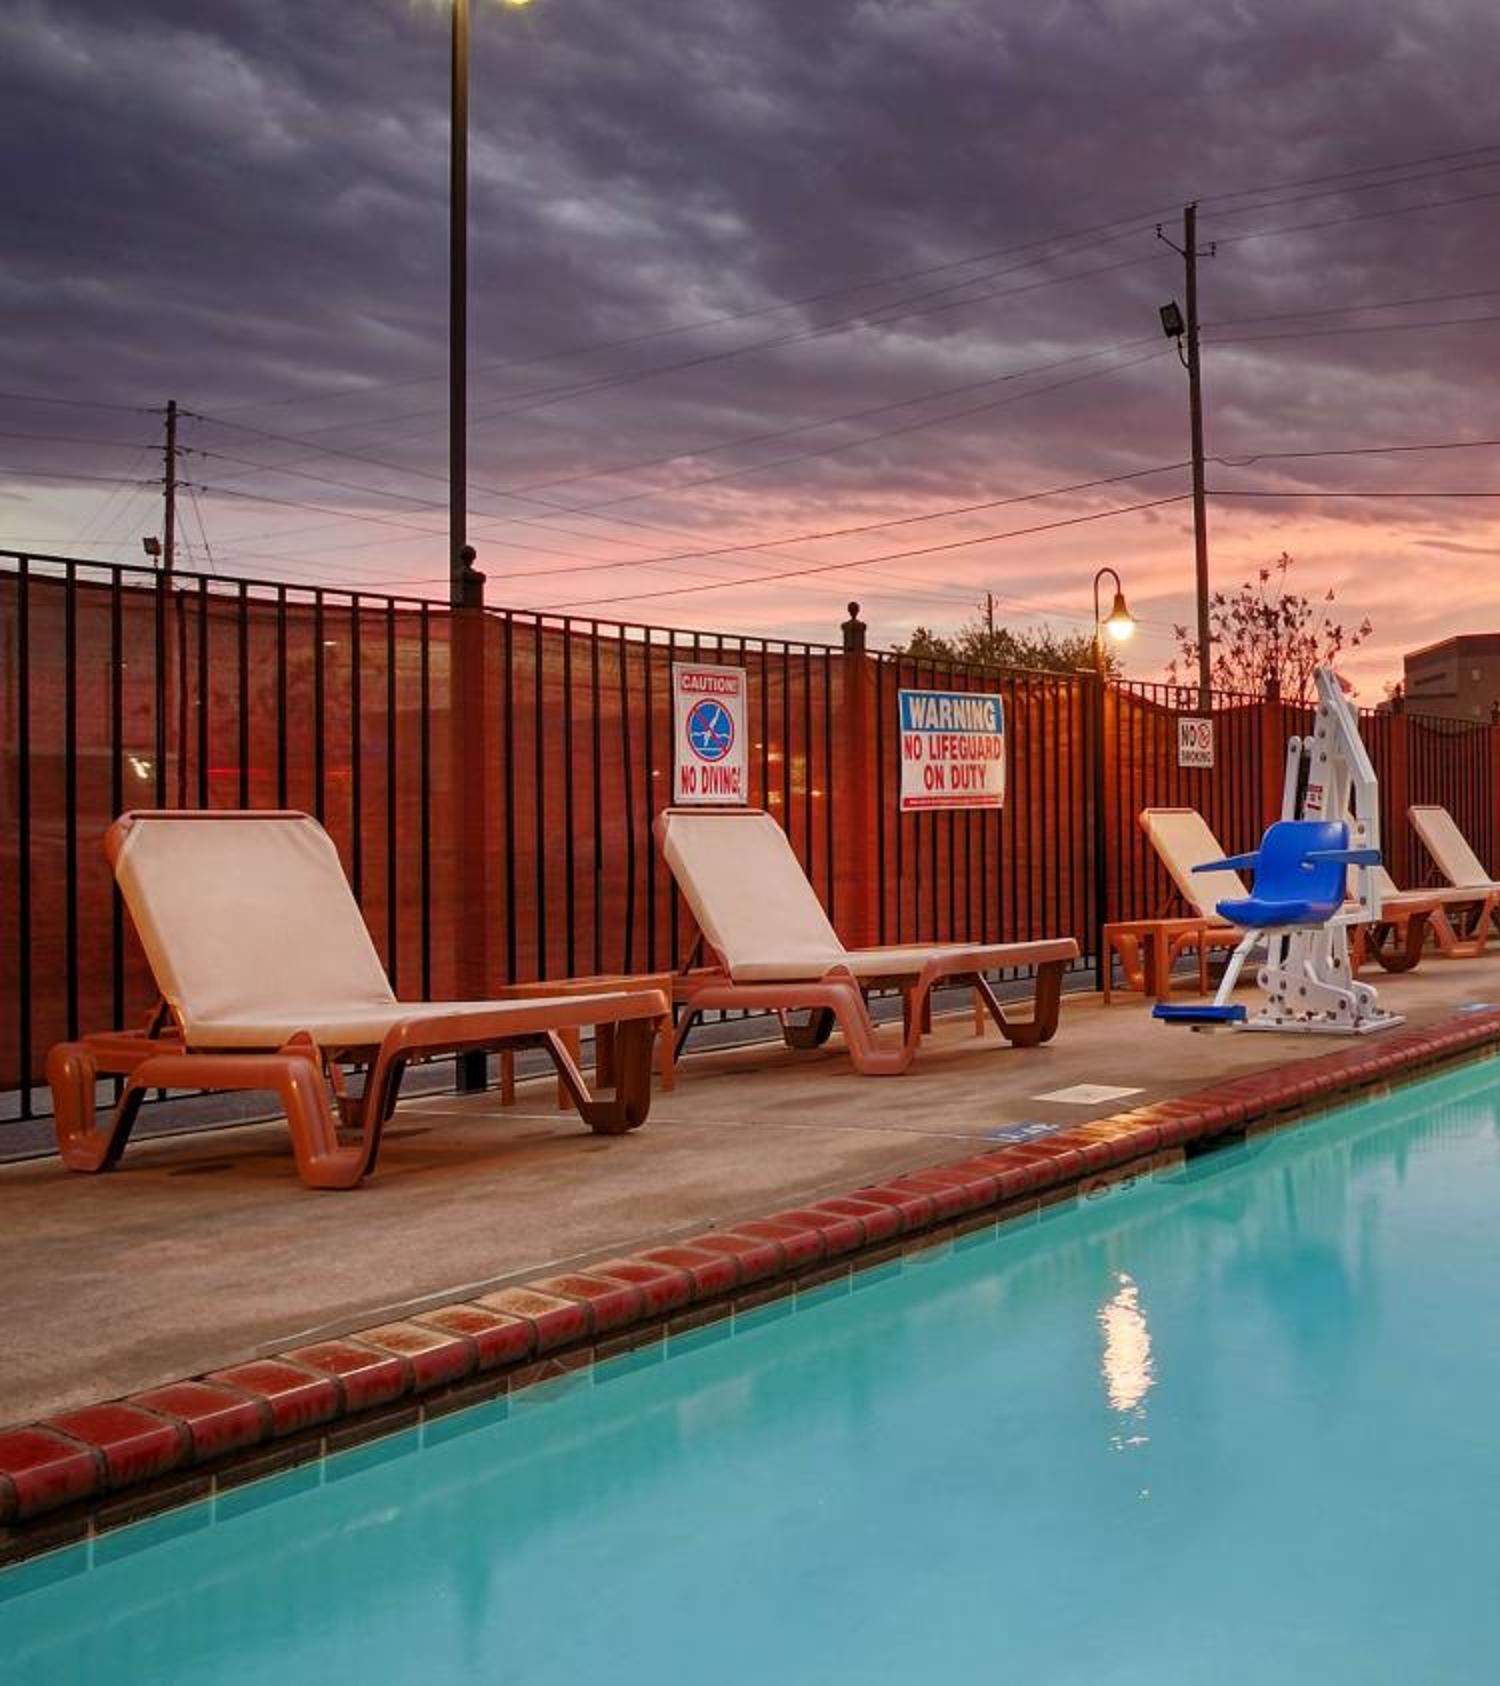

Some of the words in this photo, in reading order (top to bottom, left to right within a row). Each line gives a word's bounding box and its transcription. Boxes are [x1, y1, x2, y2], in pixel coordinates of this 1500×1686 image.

[682, 674, 738, 693] CAUTION!
[909, 696, 996, 731] WARNING
[904, 734, 922, 760] NO
[929, 734, 1001, 760] LIFEGUARD
[1181, 724, 1197, 747] NO
[681, 765, 696, 795] NO
[701, 765, 741, 795] DIVING!
[924, 763, 944, 790] ON
[952, 763, 986, 790] DUTY
